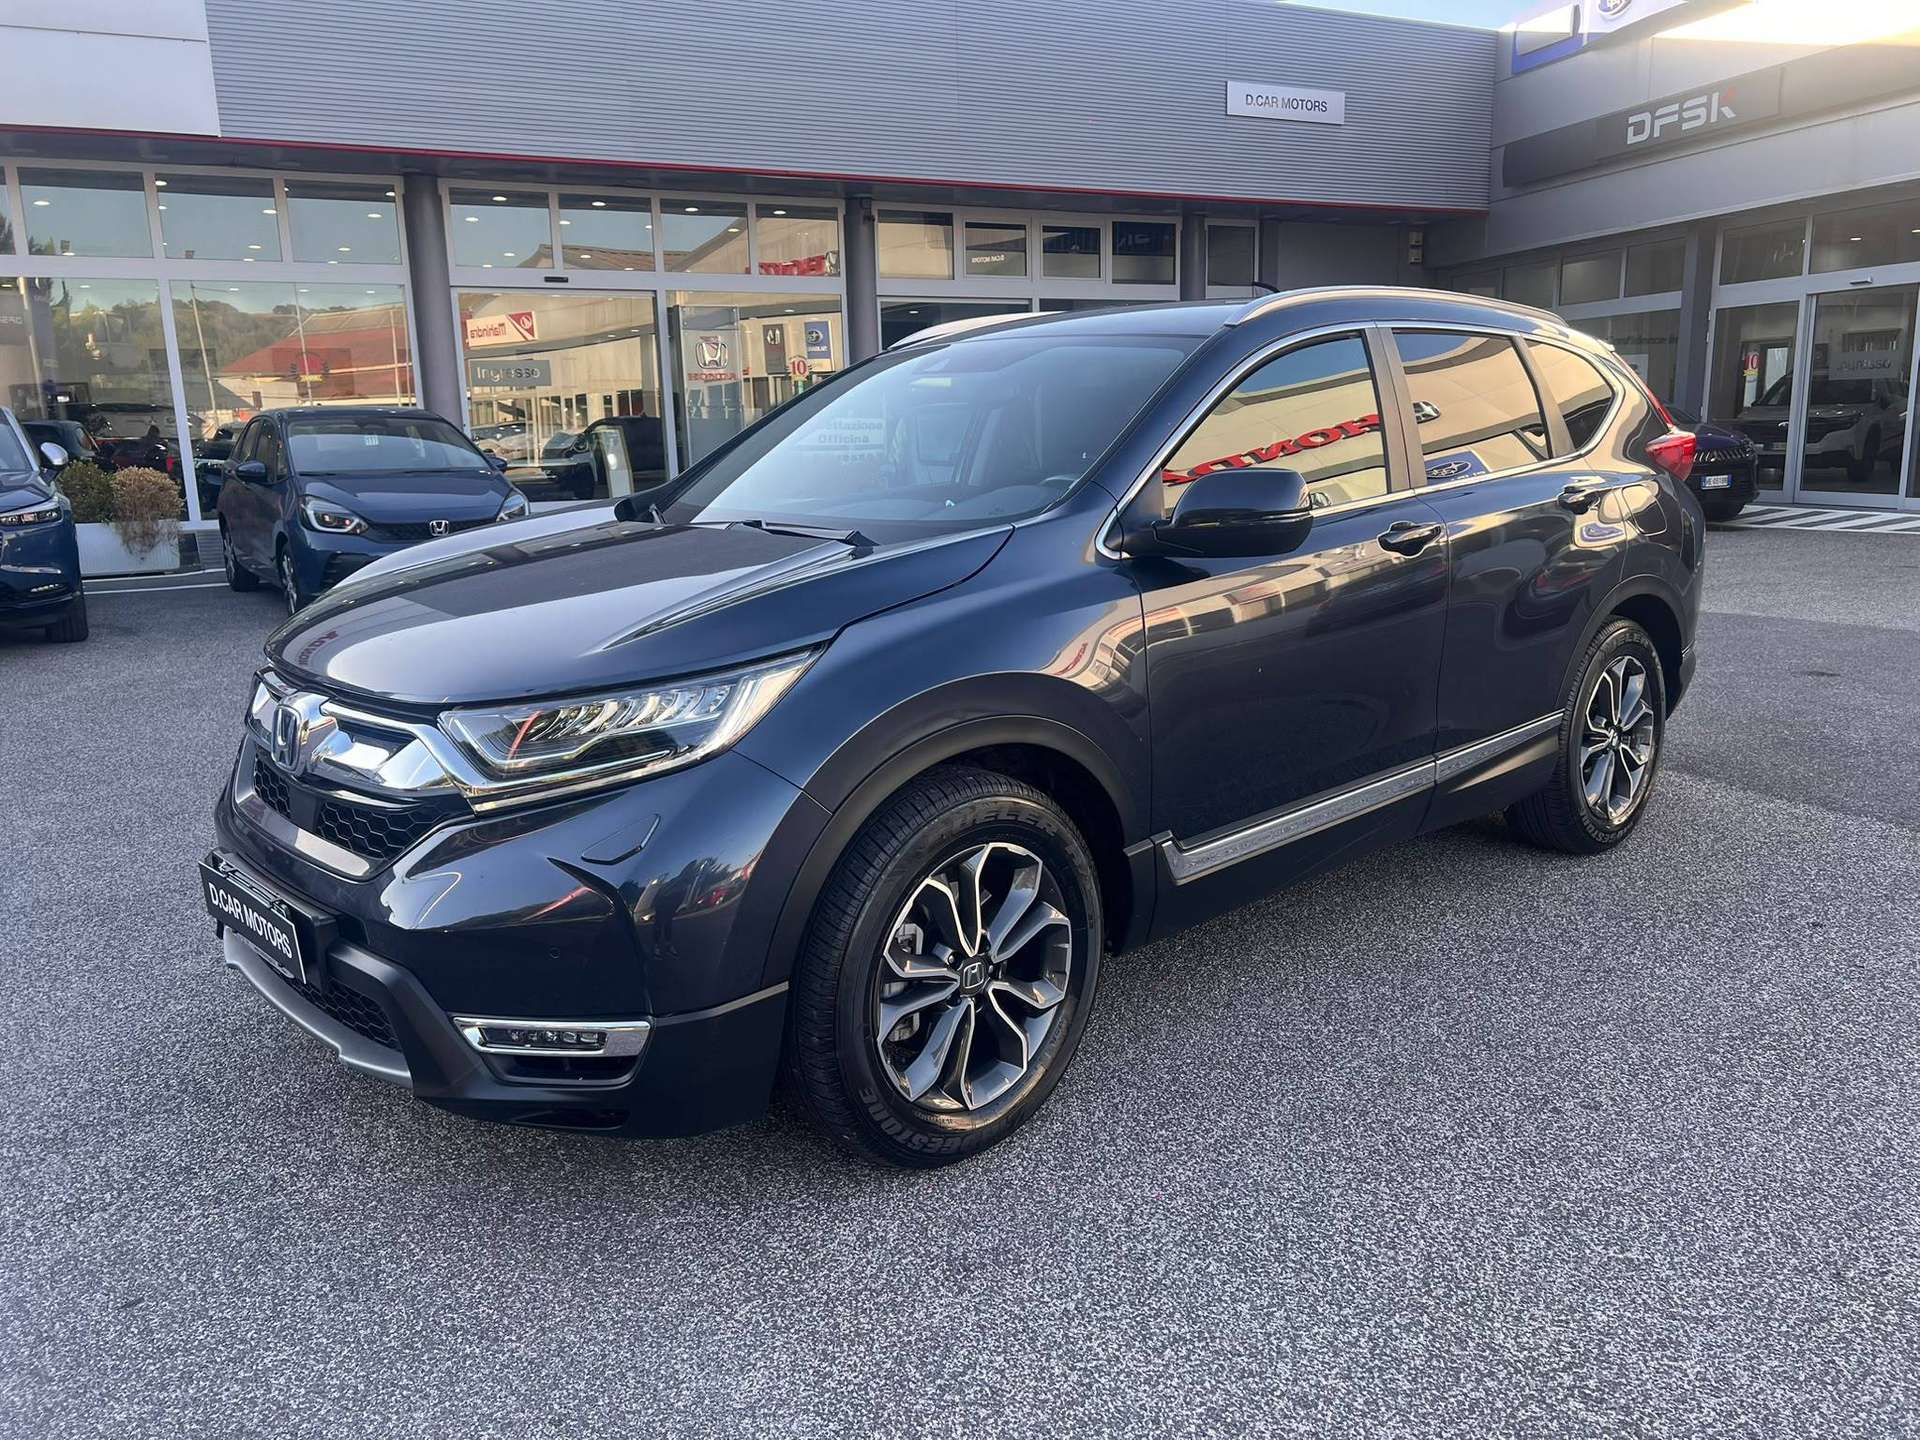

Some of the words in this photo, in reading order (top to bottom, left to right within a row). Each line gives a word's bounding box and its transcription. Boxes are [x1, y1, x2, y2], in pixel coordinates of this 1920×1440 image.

[1245, 94, 1279, 109] D.CAR
[1281, 97, 1328, 113] MOTORS
[1627, 87, 1737, 145] DFSK
[476, 367, 541, 383] Ingresso
[790, 360, 807, 376] 10
[688, 372, 737, 382] HONDA
[208, 882, 245, 923] D.CAR
[243, 904, 293, 959] MOTORS
